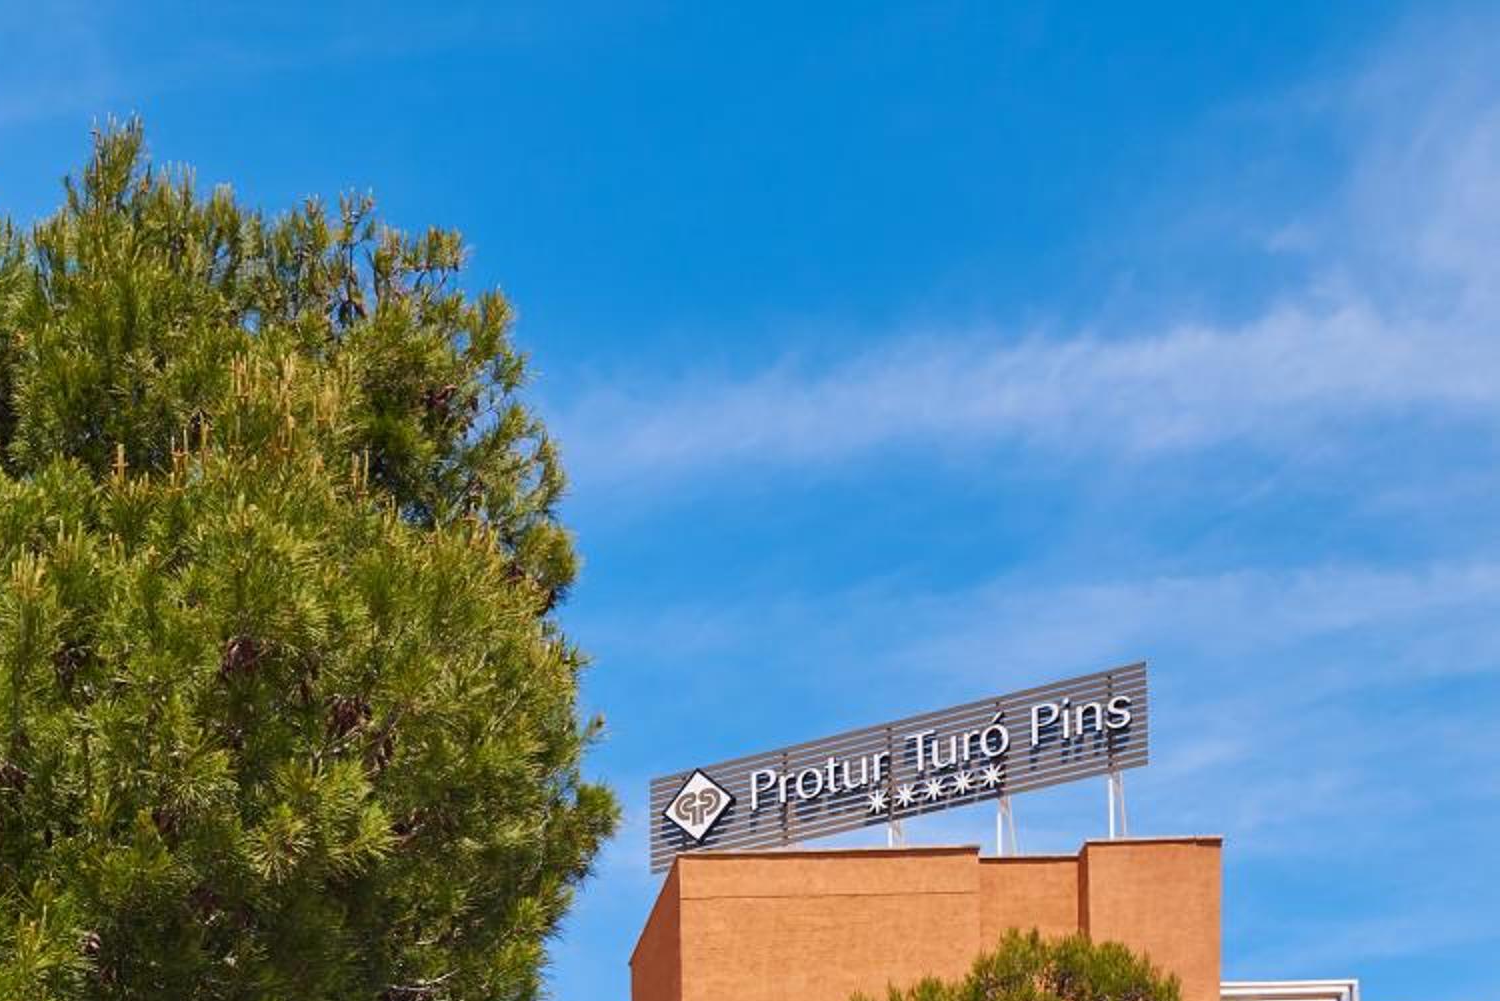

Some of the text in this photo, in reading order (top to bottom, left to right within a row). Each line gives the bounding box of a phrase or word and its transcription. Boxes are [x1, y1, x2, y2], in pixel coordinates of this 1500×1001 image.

[750, 695, 1133, 810] Protur Turó Pins
